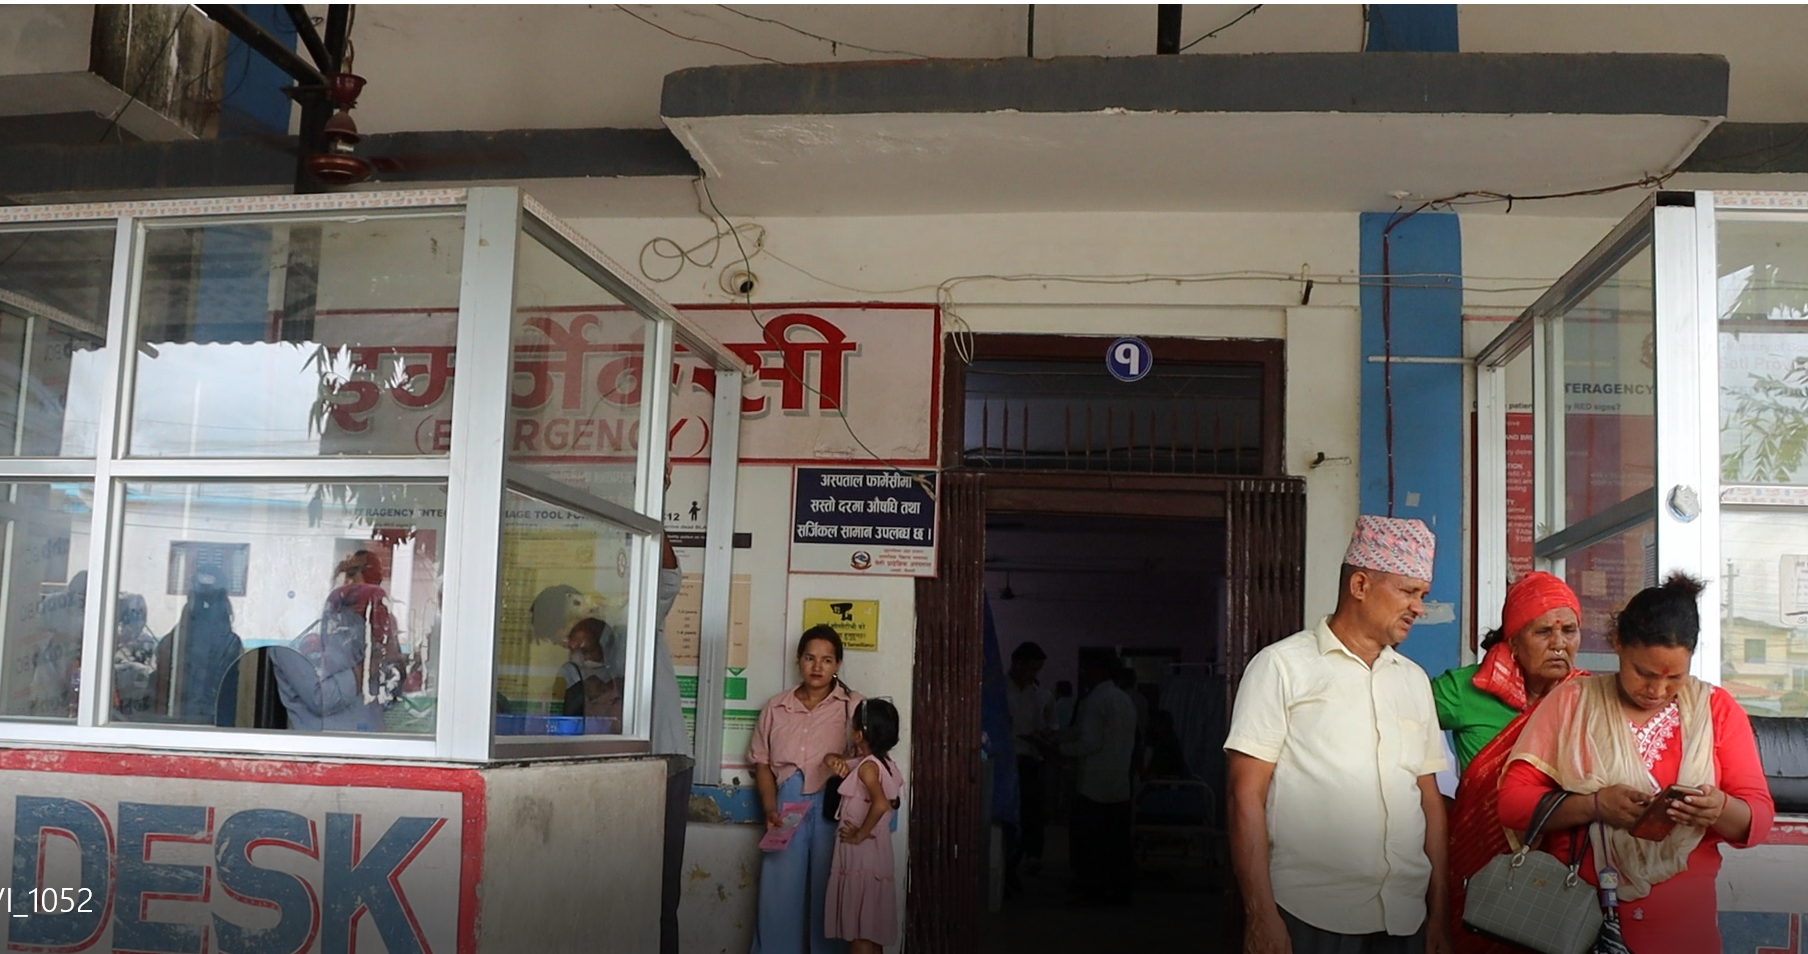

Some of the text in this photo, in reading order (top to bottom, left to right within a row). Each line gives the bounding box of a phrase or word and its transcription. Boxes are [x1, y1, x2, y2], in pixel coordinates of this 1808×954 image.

[1565, 383, 1655, 394] TERAGENCY
[820, 473, 863, 488] अस्पताल
[810, 496, 835, 513] सस्तो
[838, 500, 864, 514] दरमा
[901, 501, 921, 515] तथा
[505, 510, 531, 518] IAGE
[534, 510, 563, 519] TOOL
[840, 525, 873, 539] सामान
[913, 527, 924, 541] छ
[6, 795, 448, 954] DESK
